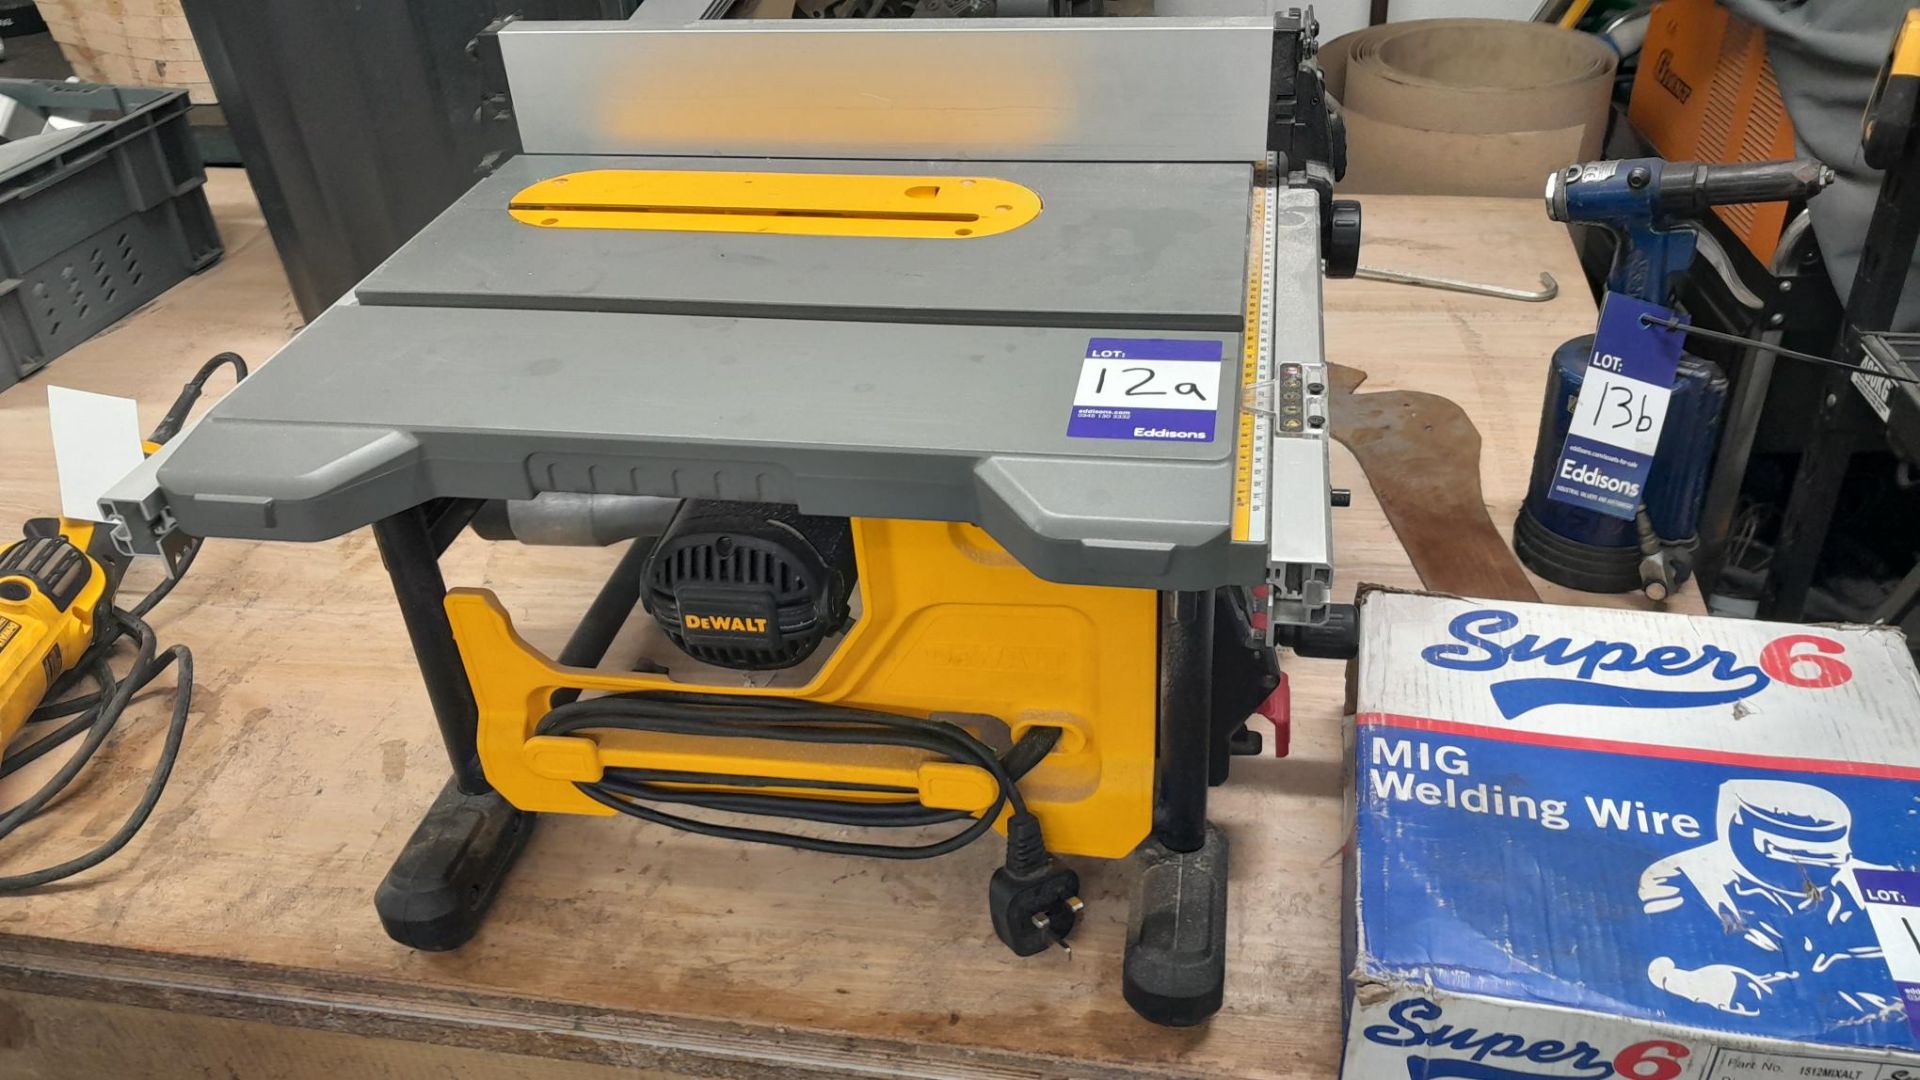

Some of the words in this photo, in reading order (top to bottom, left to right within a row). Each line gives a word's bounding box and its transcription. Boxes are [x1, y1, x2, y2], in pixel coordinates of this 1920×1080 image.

[1092, 350, 1126, 358] LOT:
[1592, 351, 1623, 372] LOT:
[1096, 367, 1207, 401] 12a
[1593, 381, 1653, 432] 13b
[1133, 427, 1207, 439] Eddisons
[1560, 458, 1640, 498] Eddisons
[1421, 609, 1770, 684] Super
[1759, 634, 1853, 688] 6
[1372, 737, 1470, 776] MIG
[1369, 768, 1571, 830] Welding
[1585, 795, 1702, 839] Wire
[1866, 889, 1907, 903] LOT:
[1363, 997, 1616, 1079] Super
[1613, 1040, 1691, 1080] 6
[1727, 1057, 1756, 1070] Part
[1761, 1062, 1785, 1073] No.
